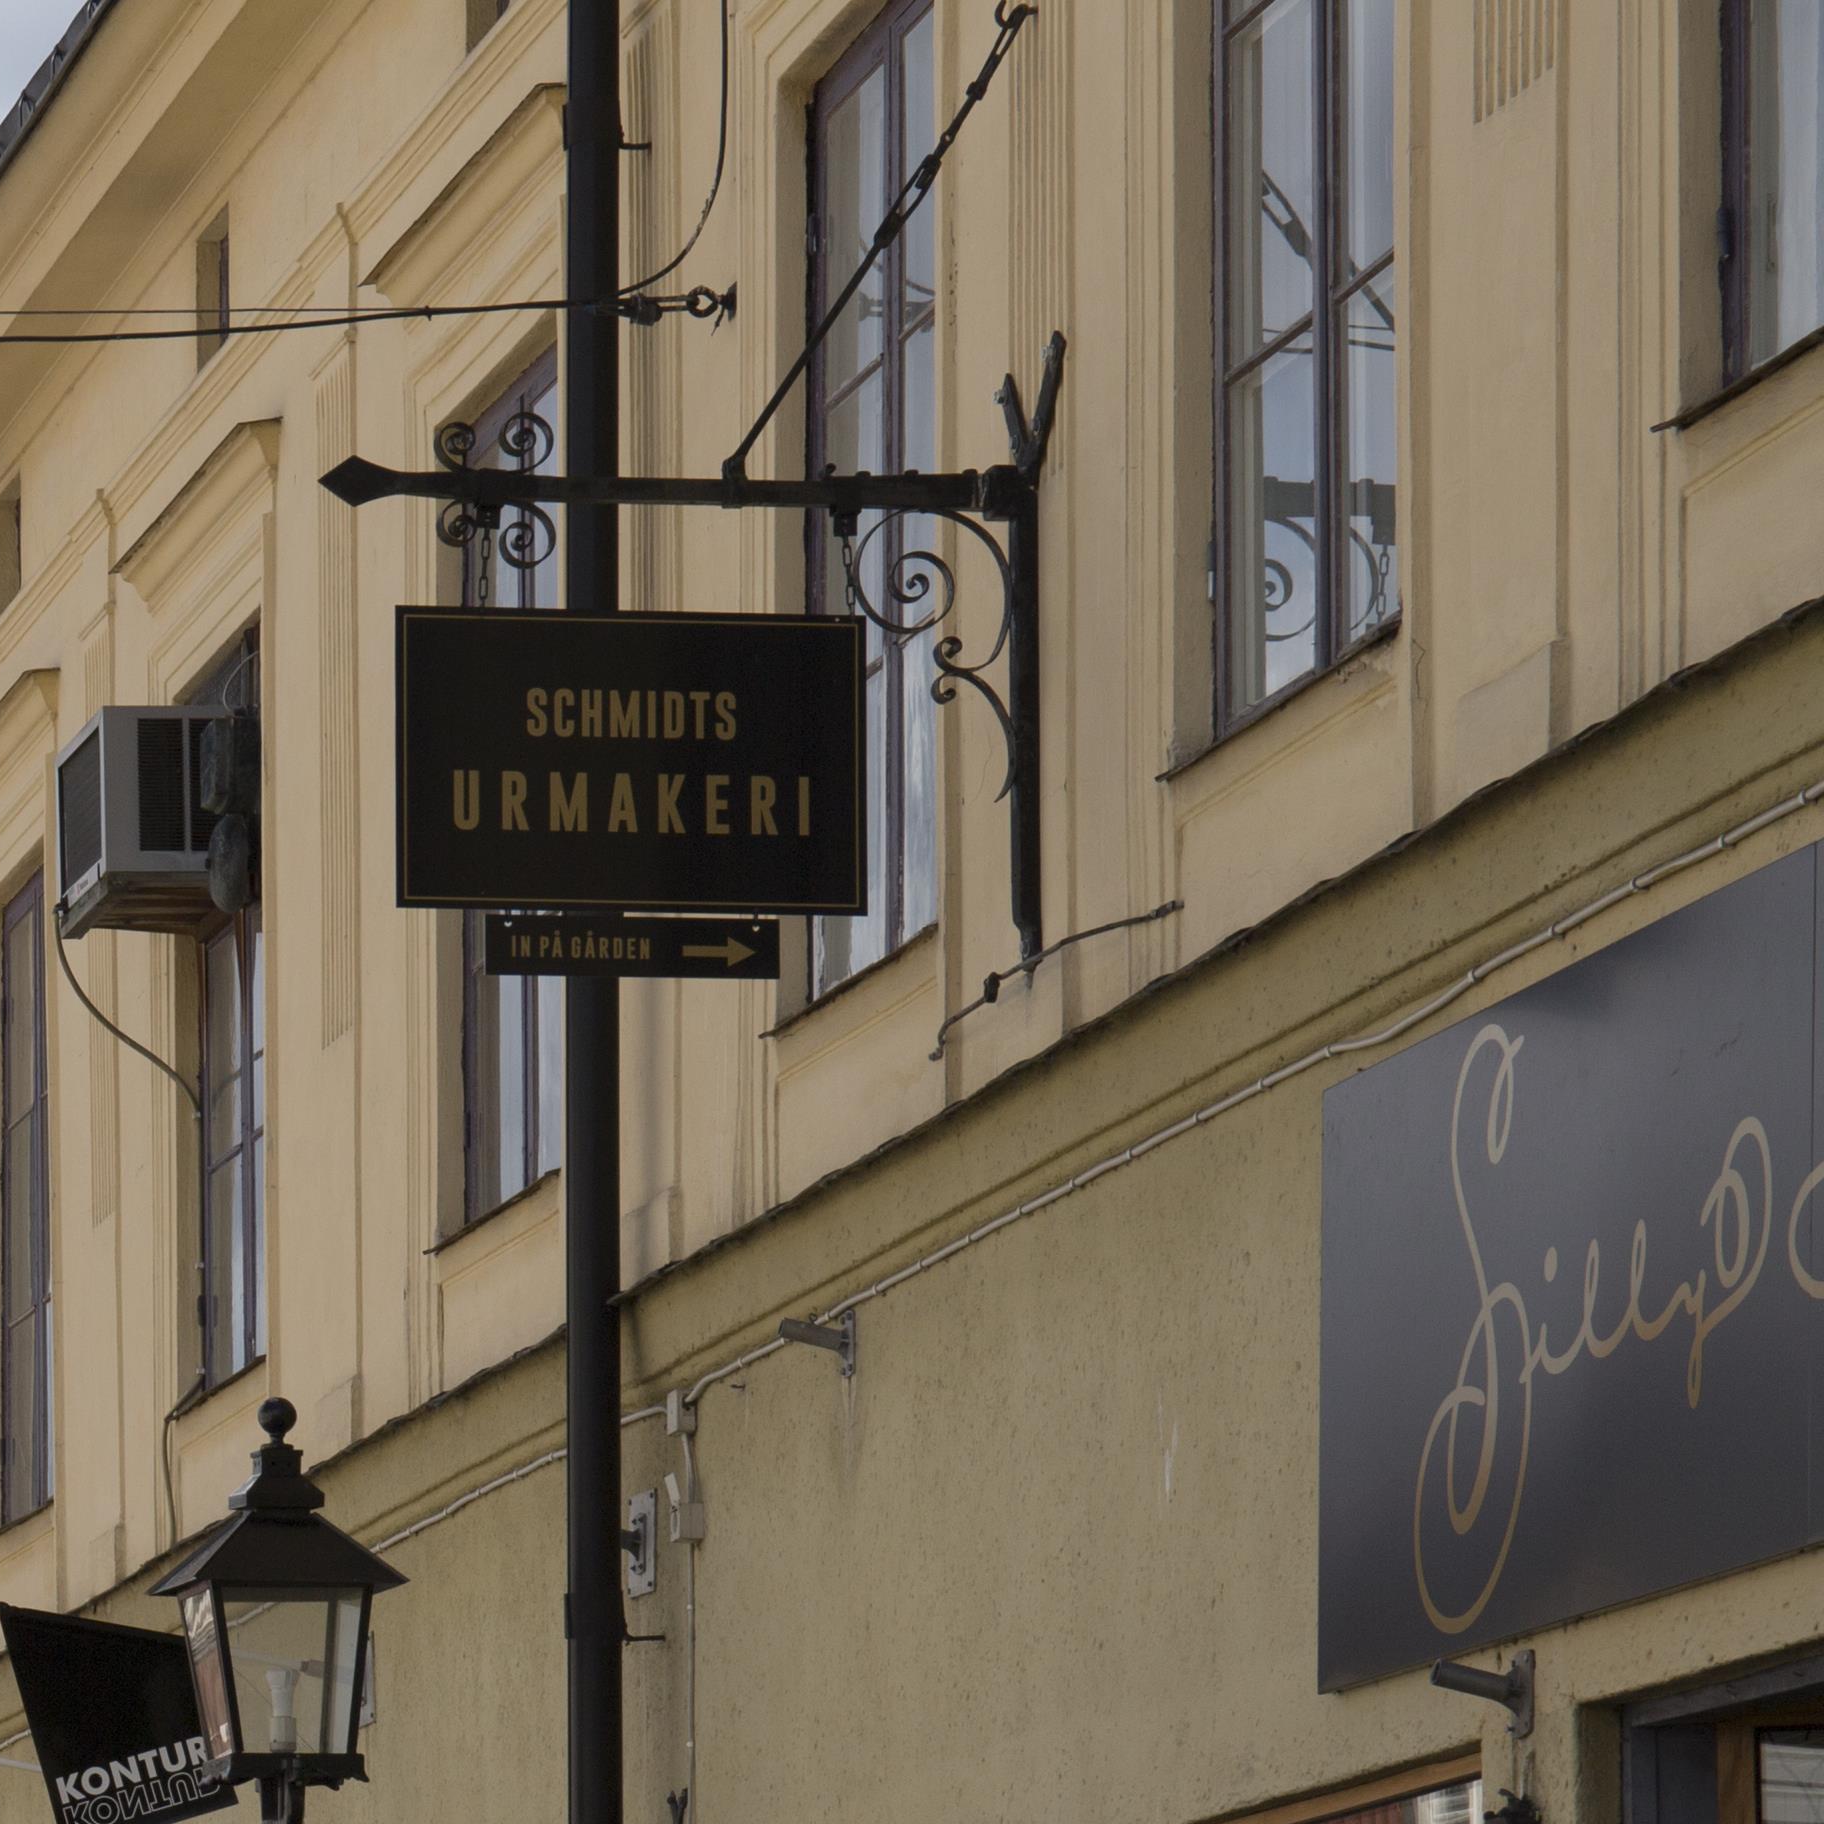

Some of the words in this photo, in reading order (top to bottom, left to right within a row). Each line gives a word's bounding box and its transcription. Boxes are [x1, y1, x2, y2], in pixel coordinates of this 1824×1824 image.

[525, 687, 738, 741] SCHMIDTS
[452, 768, 811, 837] URMAKERI
[510, 934, 532, 960] IN
[538, 929, 564, 960] PÅ
[570, 929, 652, 961] GÅRDEN
[55, 1736, 209, 1805] KONTUR
